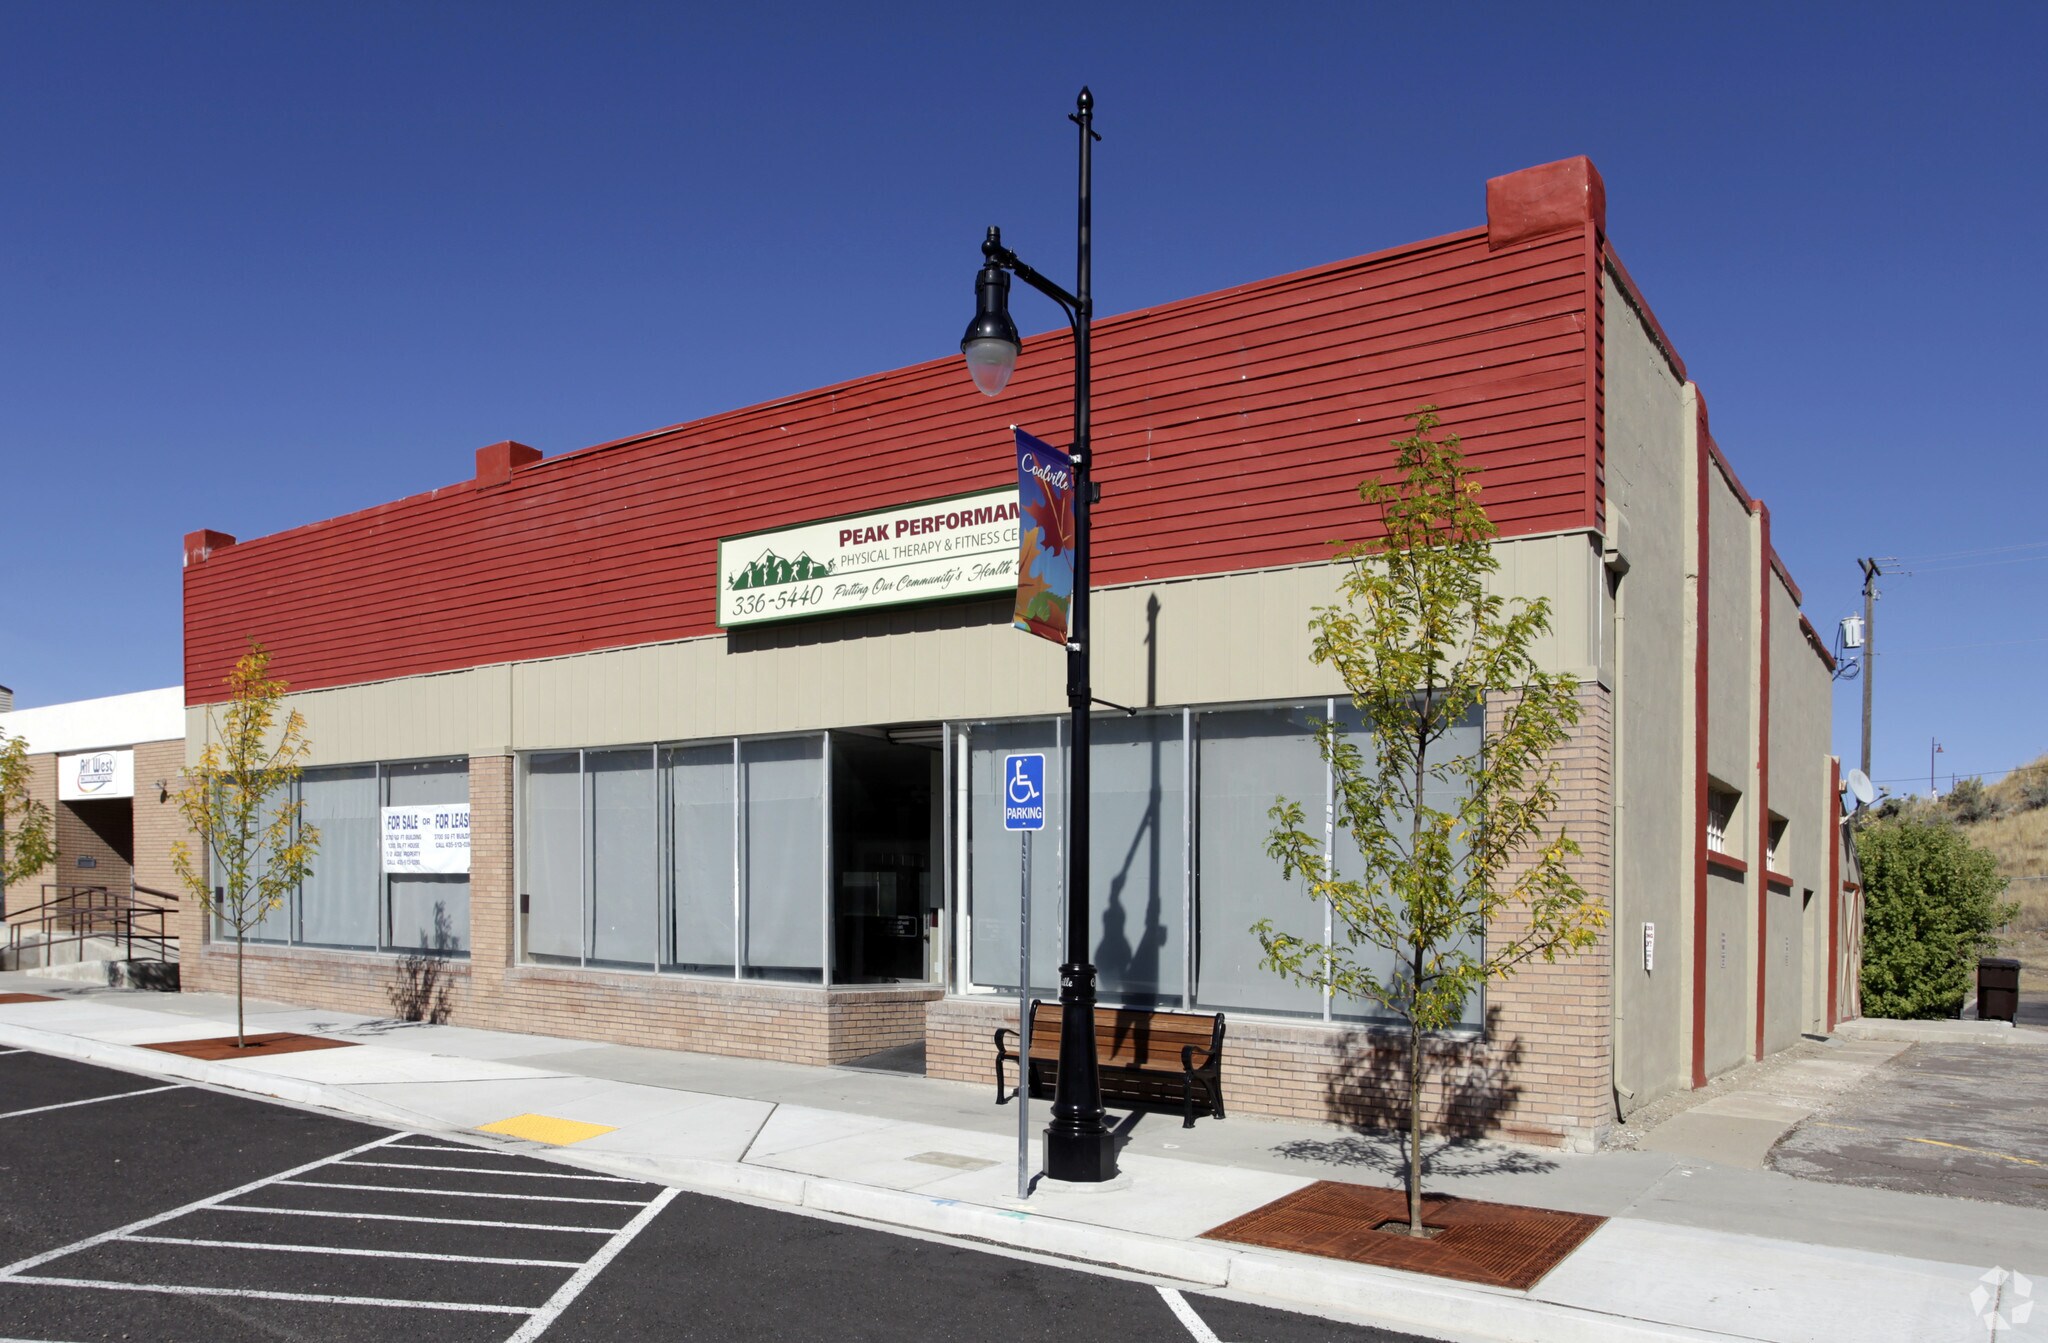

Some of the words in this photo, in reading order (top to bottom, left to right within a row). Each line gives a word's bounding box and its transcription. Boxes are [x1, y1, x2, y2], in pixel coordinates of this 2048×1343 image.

[1021, 453, 1070, 490] Coalville
[839, 524, 890, 547] PEAK
[841, 548, 890, 567] PHYSICAL
[893, 540, 942, 559] THERAPY
[944, 538, 952, 551] &
[955, 531, 1000, 550] FITNESS
[1003, 528, 1019, 542] CE
[833, 583, 869, 601] Putting
[872, 577, 894, 595] Our
[896, 567, 962, 592] Community's
[968, 560, 1013, 581] Health
[732, 585, 823, 616] 336-5440
[93, 757, 112, 773] West
[387, 815, 400, 830] FOR
[403, 814, 418, 830] SALE
[422, 817, 430, 825] OR
[435, 813, 449, 829] FOR
[1007, 807, 1042, 820] PARKING
